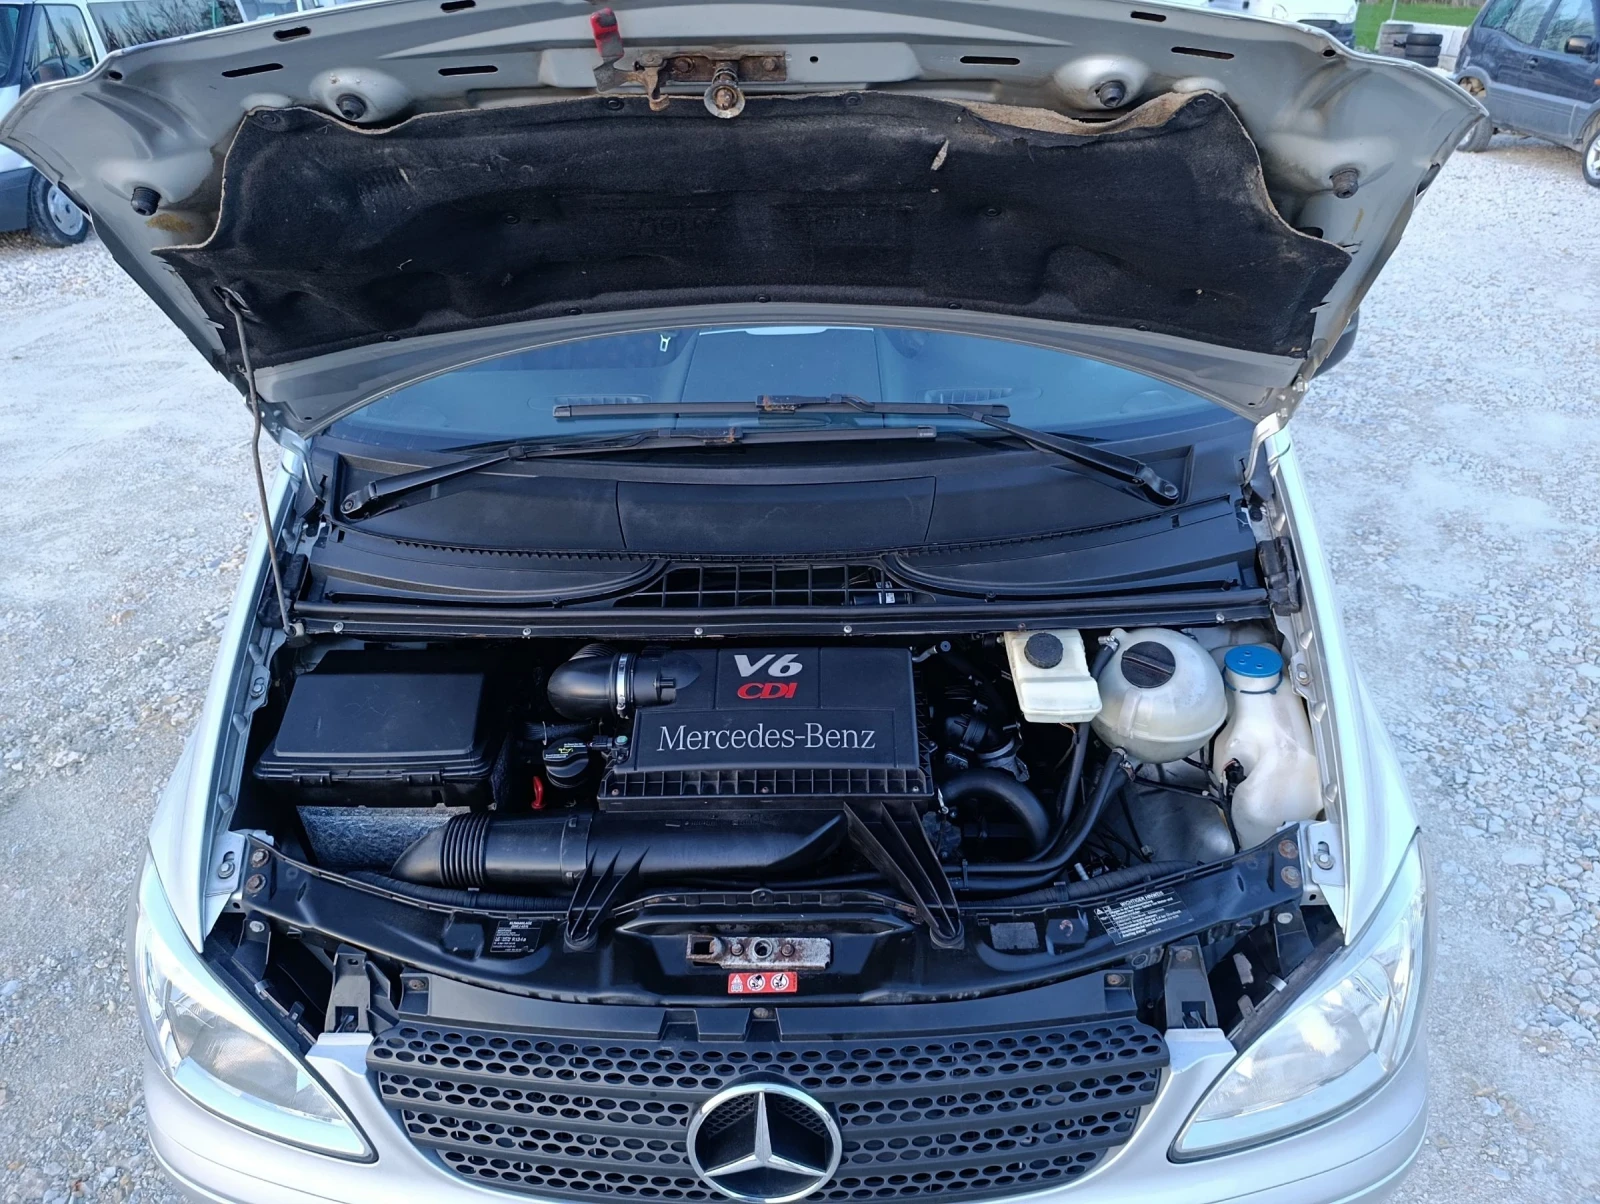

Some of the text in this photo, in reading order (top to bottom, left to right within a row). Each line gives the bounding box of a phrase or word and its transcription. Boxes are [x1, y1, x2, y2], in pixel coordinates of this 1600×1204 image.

[733, 653, 803, 678] V6
[737, 682, 798, 700] CDI
[656, 722, 876, 752] Mercedes-Benz
